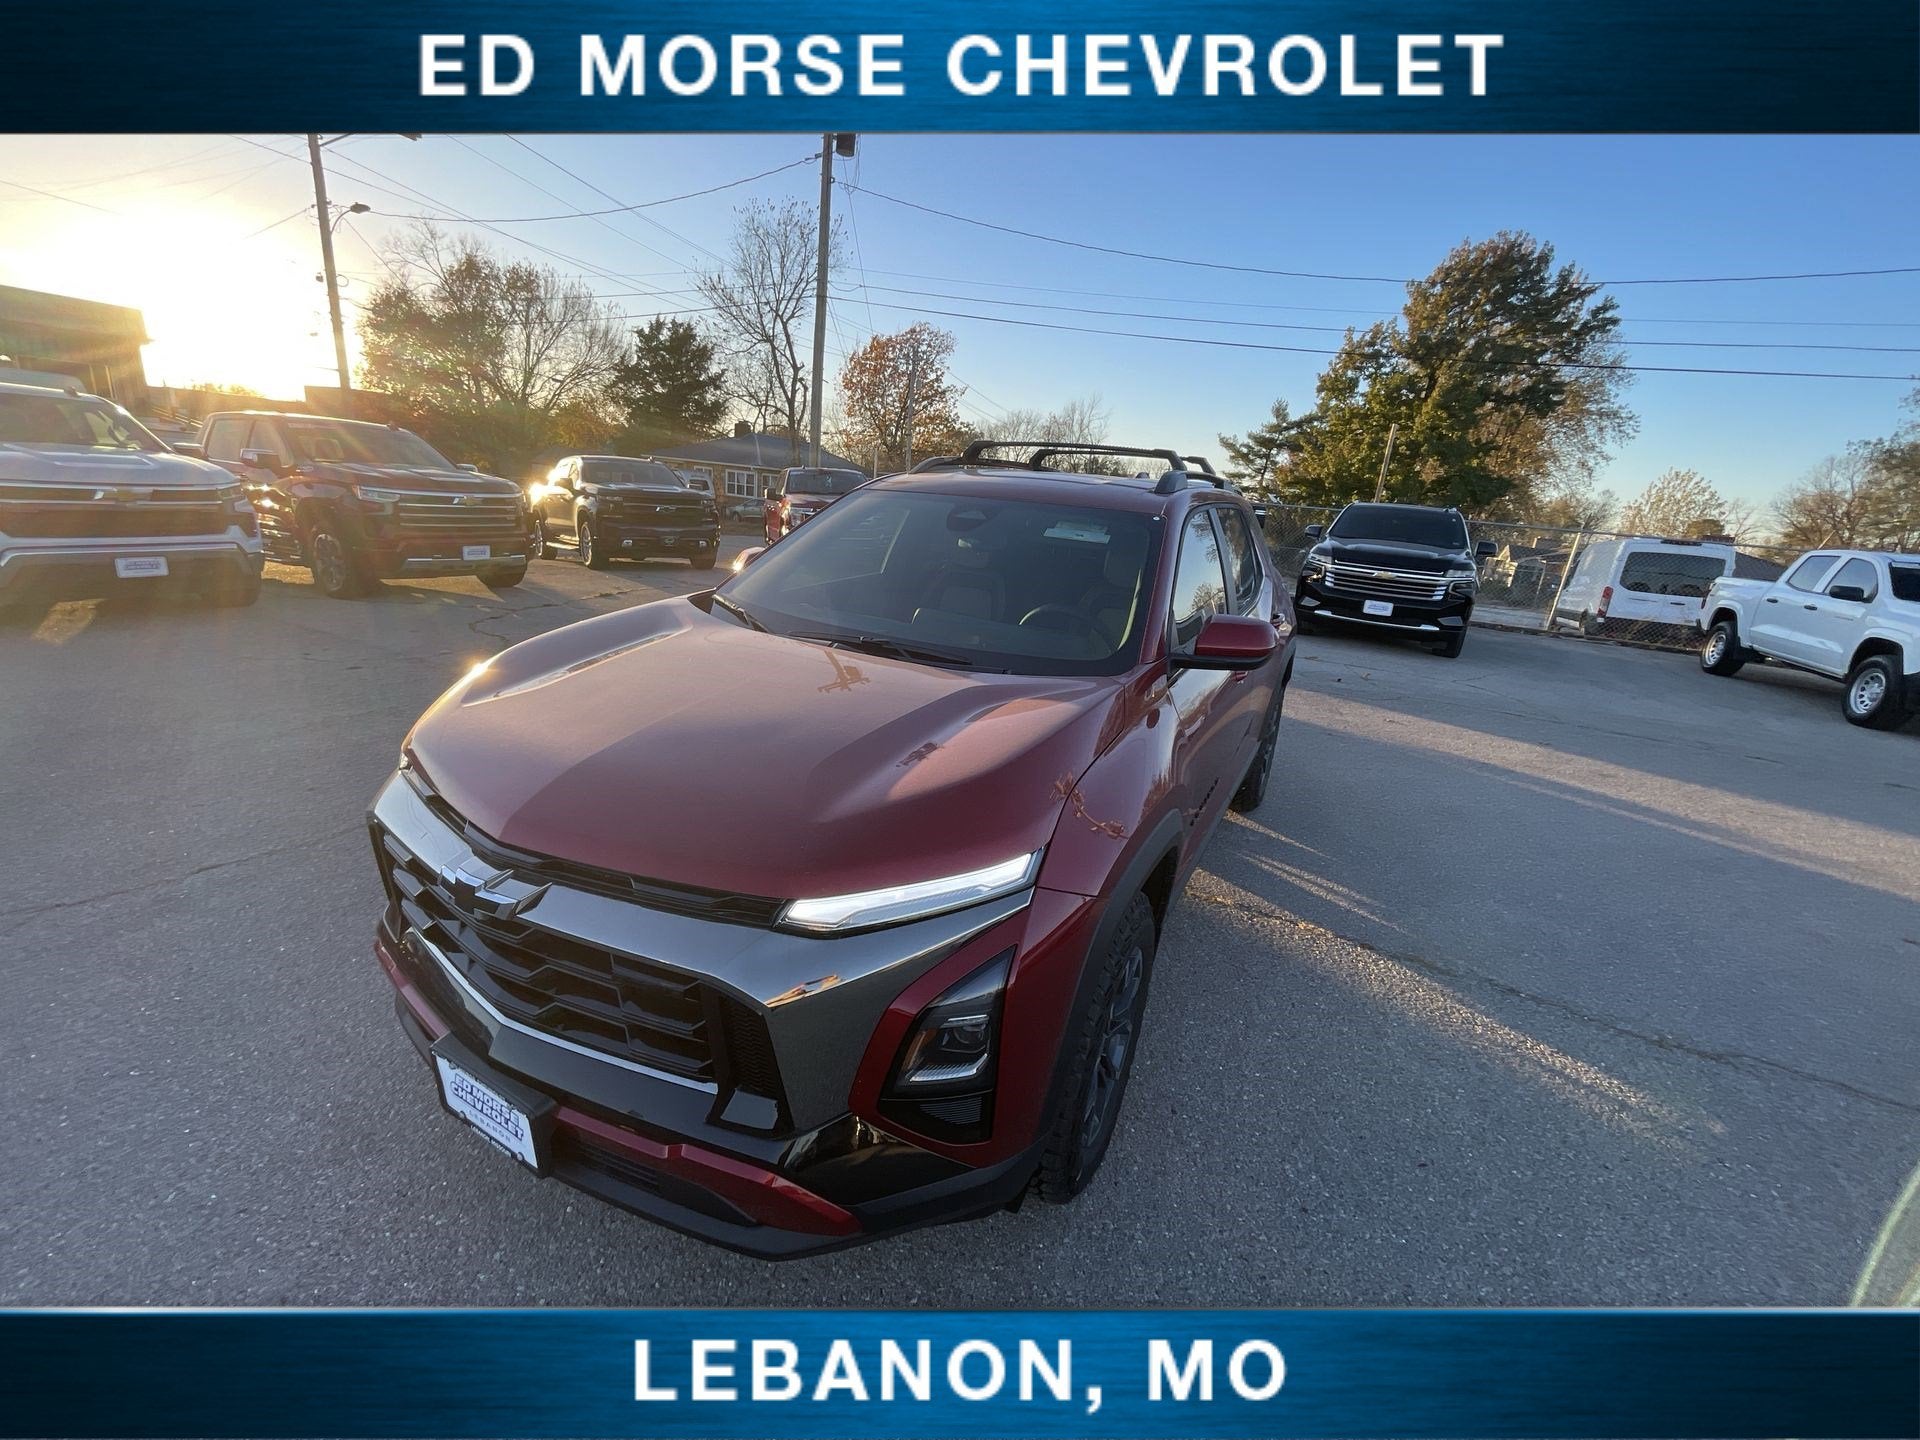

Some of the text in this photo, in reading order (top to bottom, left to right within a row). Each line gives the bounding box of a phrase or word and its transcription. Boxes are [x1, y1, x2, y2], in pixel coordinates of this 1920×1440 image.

[450, 1081, 524, 1141] CHEVROLET
[455, 1073, 472, 1093] ED
[472, 1085, 520, 1126] MORSE
